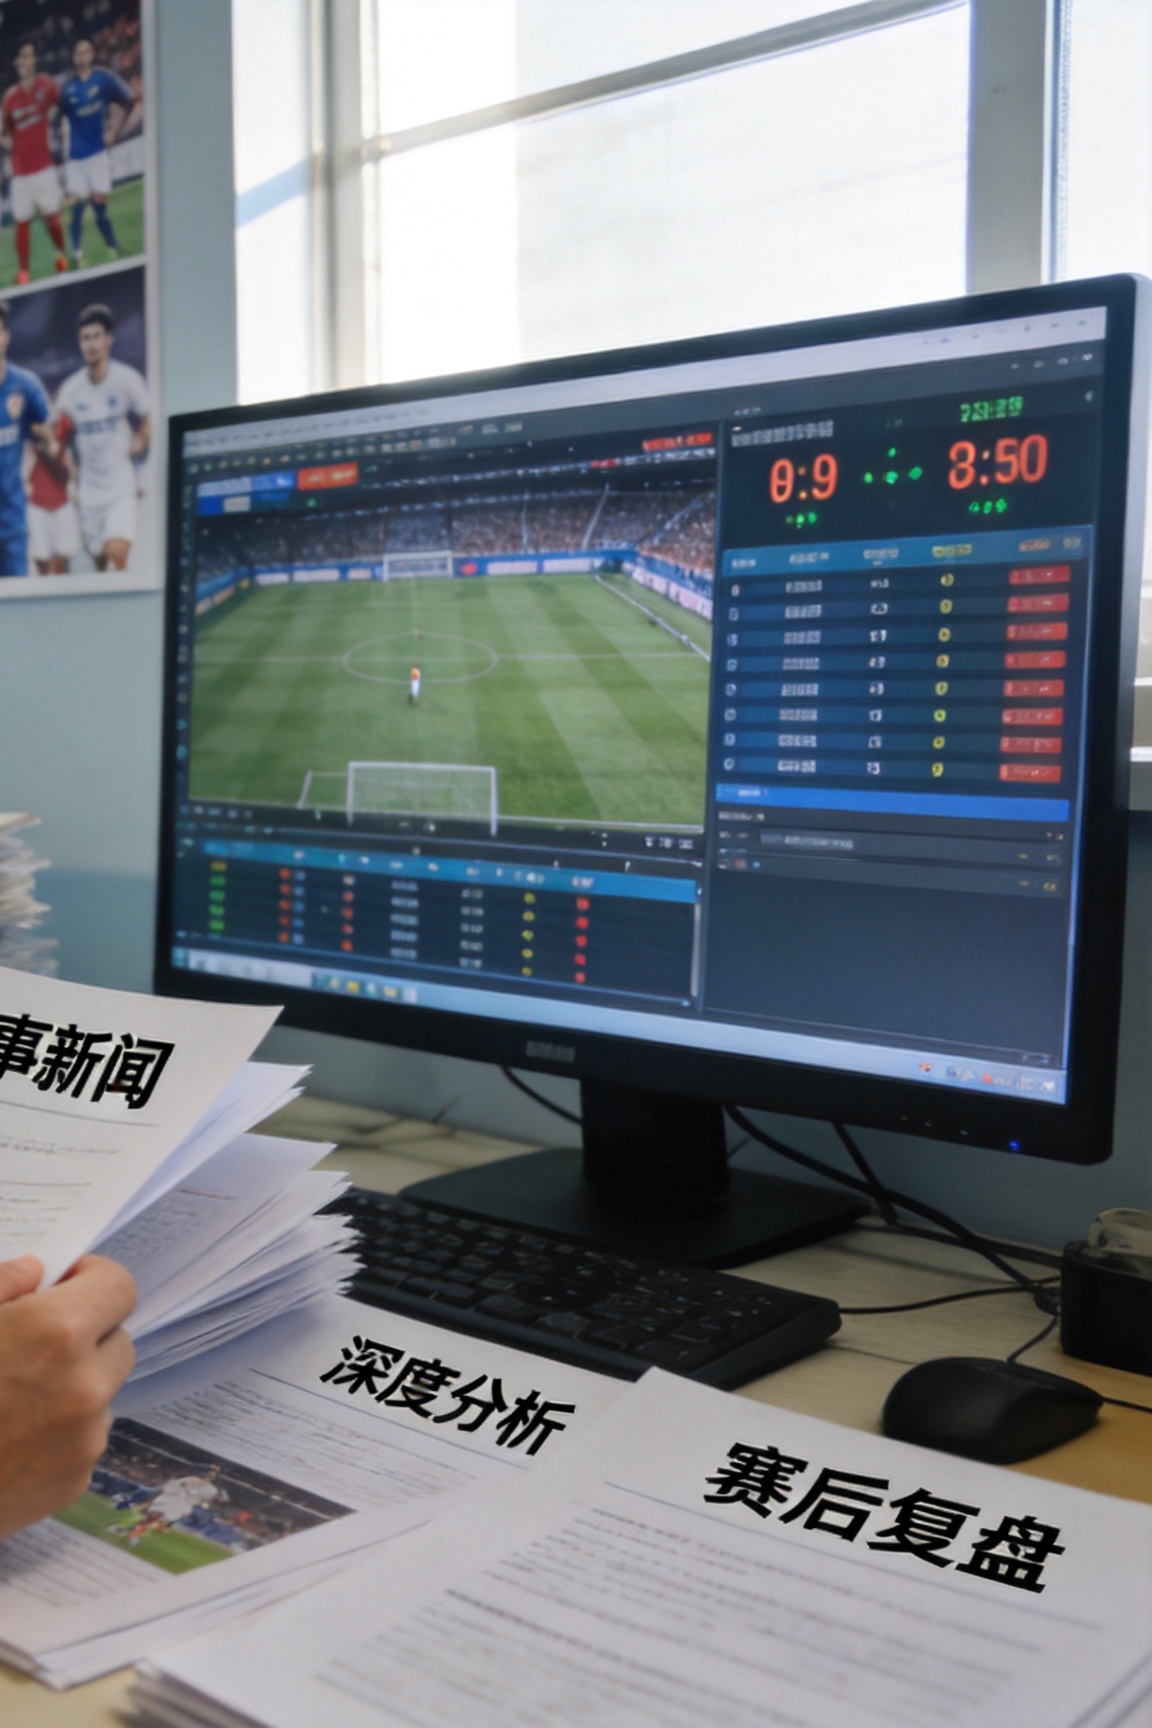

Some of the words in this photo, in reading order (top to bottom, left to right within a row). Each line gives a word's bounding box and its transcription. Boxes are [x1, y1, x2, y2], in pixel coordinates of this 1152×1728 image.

[319, 1333, 577, 1456] 深度分析
[703, 1441, 1065, 1594] 赛后复盘
